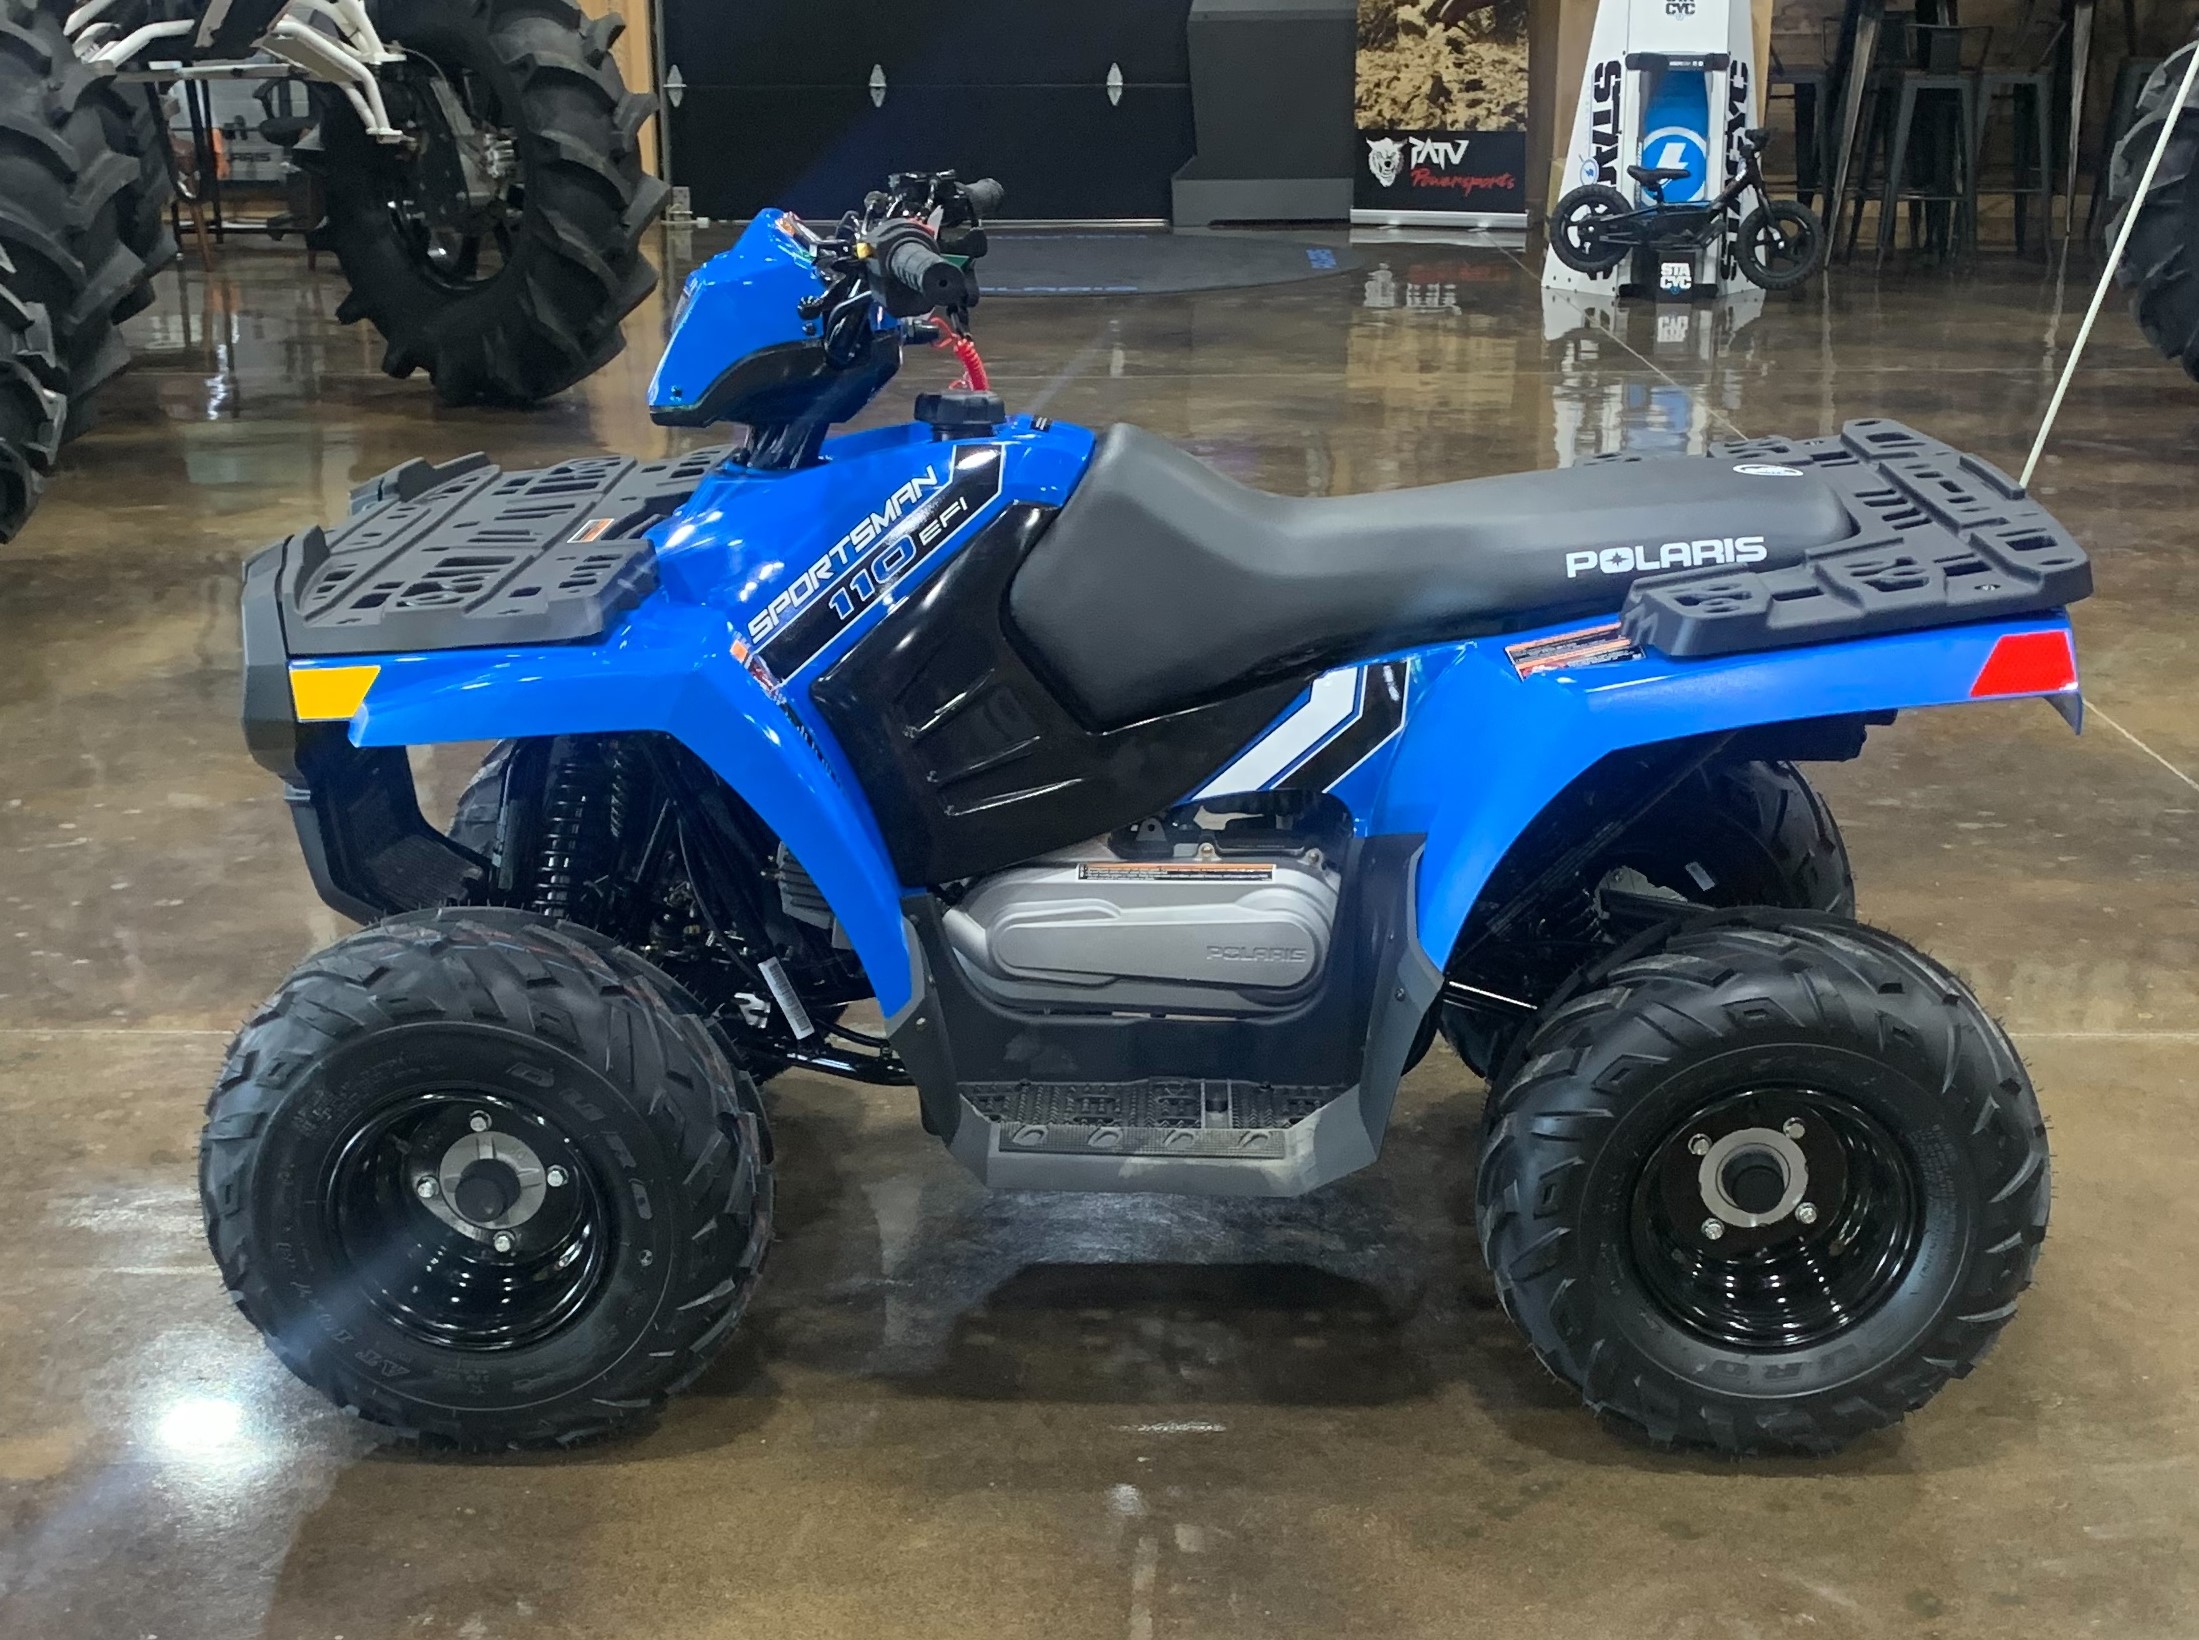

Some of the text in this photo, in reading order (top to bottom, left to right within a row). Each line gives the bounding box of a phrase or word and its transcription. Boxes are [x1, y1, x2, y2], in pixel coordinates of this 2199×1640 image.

[1660, 276, 1692, 289] CYC
[1661, 263, 1690, 275] STA
[748, 465, 938, 644] SPORTSMAN
[829, 496, 968, 620] 110 EFI
[1565, 536, 1767, 578] POLARIS
[1206, 945, 1307, 962] POLARIS
